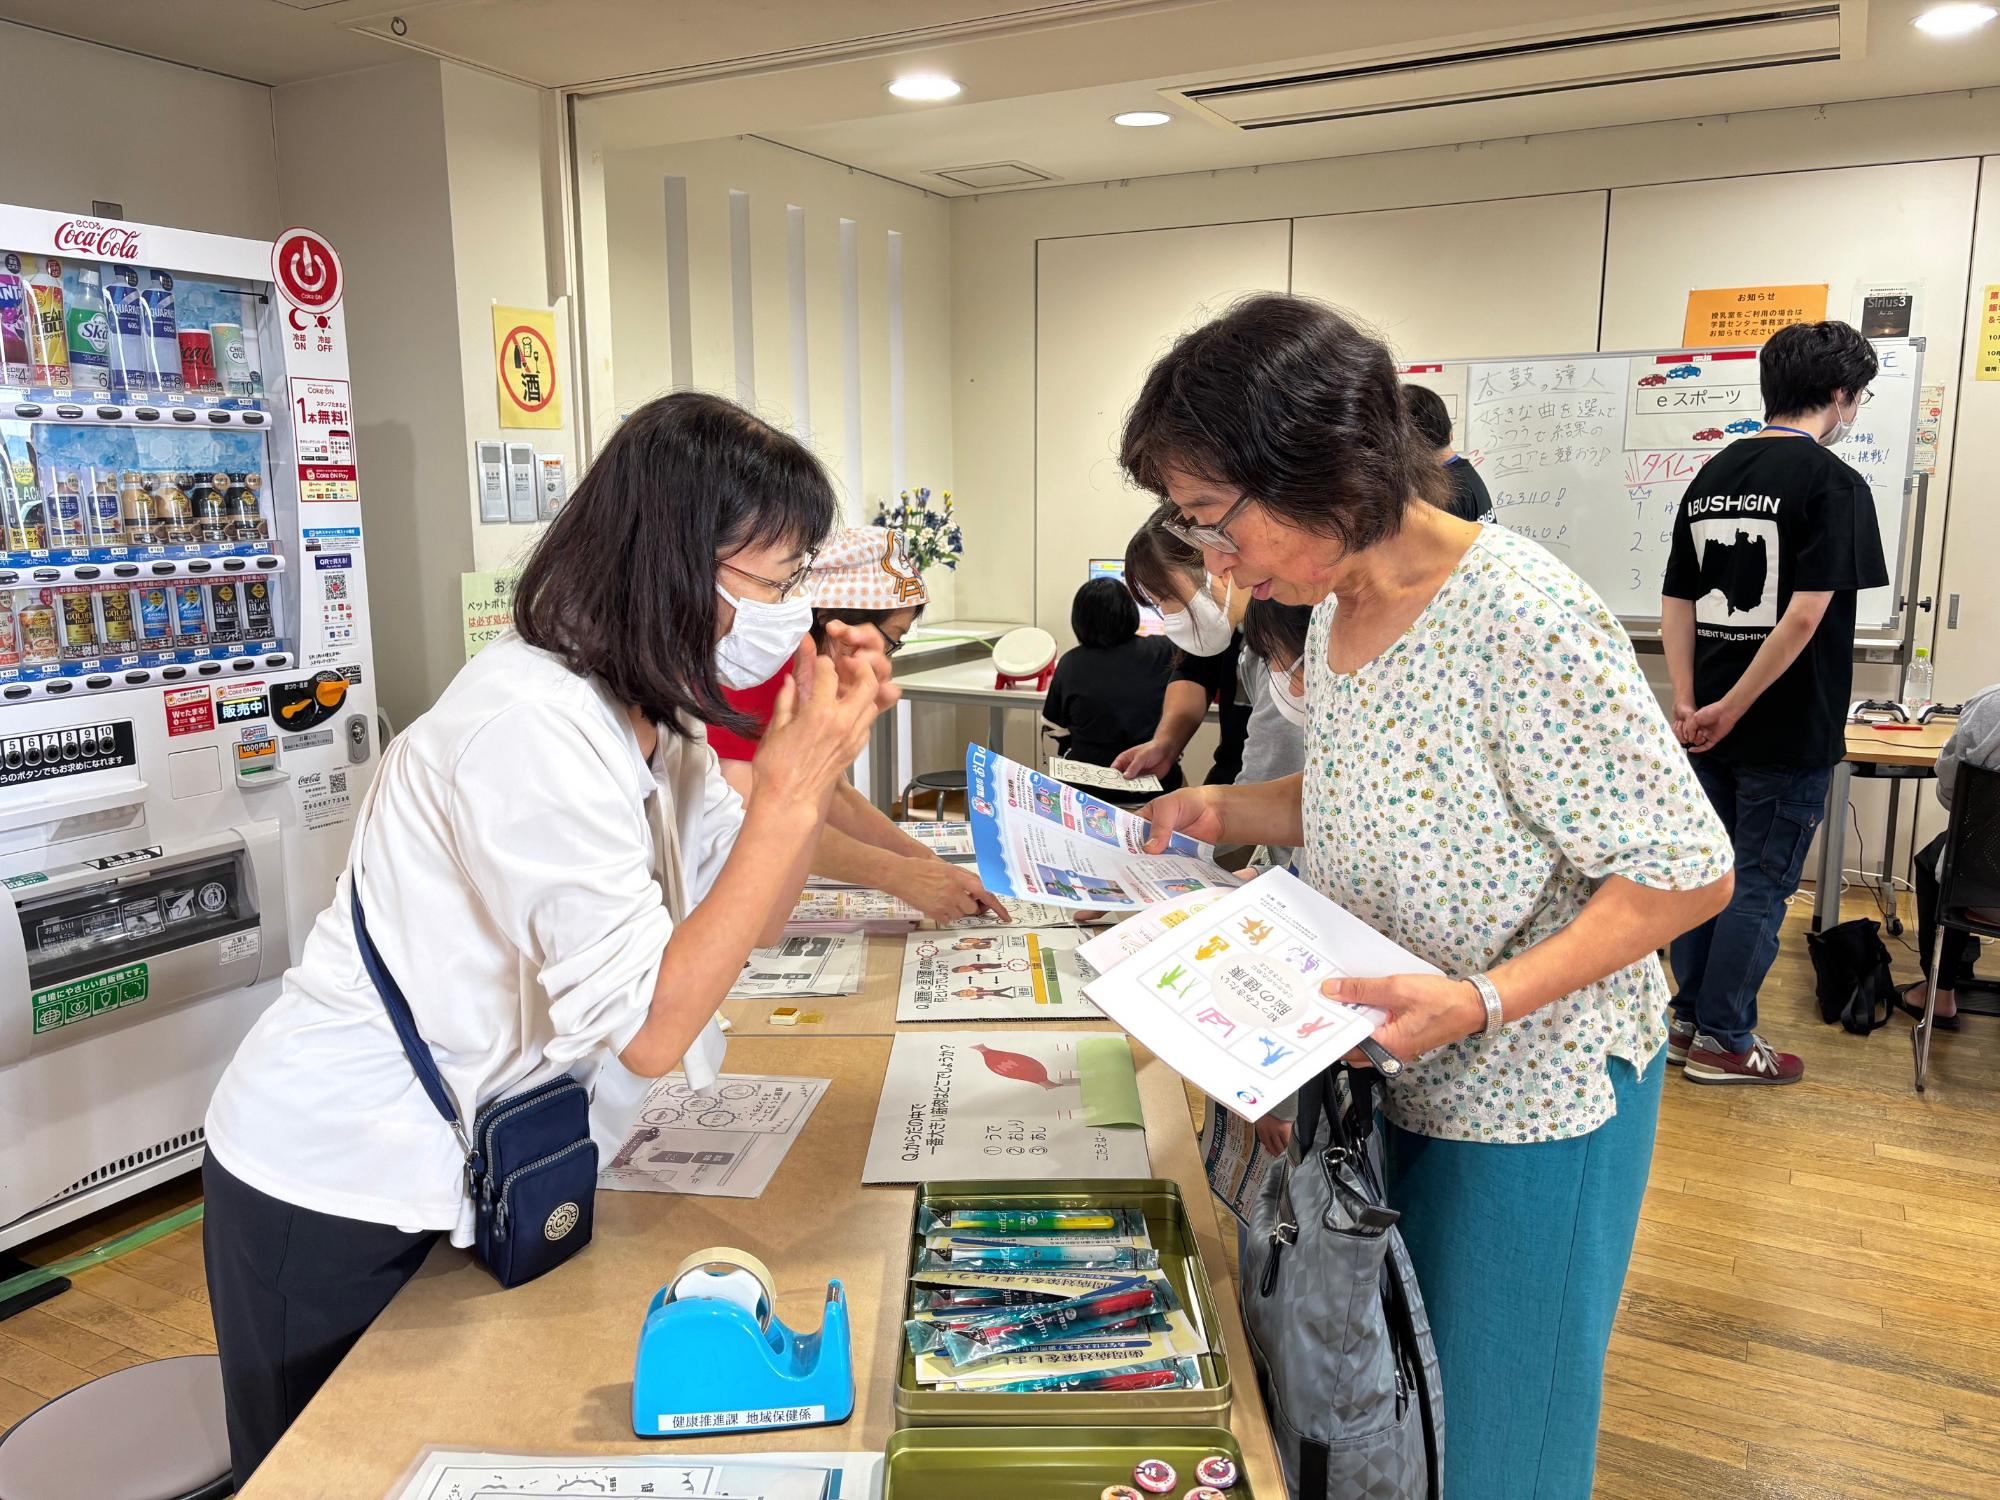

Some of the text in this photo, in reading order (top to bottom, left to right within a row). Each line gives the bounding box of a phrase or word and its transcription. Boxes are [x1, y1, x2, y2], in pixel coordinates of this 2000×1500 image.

[54, 221, 142, 260] Coca-Cola
[1738, 292, 1775, 302] お知らせ
[1868, 296, 1906, 308] Sirius3
[1711, 309, 1803, 320] 授乳室をご利用の場合は
[294, 342, 306, 350] ON
[317, 344, 332, 352] OFF
[60, 371, 68, 385] 5
[99, 373, 107, 387] 6
[242, 383, 253, 397] 10
[522, 372, 541, 403] 酒
[1676, 390, 1741, 406] スポーツ
[172, 706, 208, 719] Wでたまる!
[223, 701, 262, 718] 販売中
[66, 732, 73, 741] 8
[84, 729, 91, 738] 9
[100, 726, 112, 736] 10
[9, 741, 16, 750] 5
[28, 738, 35, 747] 6
[47, 735, 54, 744] 7
[1746, 1051, 1768, 1073] N
[927, 1044, 955, 1155] 一番大きい筋肉はどこでしょうか?
[901, 1103, 927, 1161] Q.からだの中で
[984, 1125, 1003, 1142] うで
[1006, 1119, 1025, 1142] おしり
[1030, 1126, 1048, 1142] あし
[672, 1407, 813, 1429] 健康推進課 地域保健係
